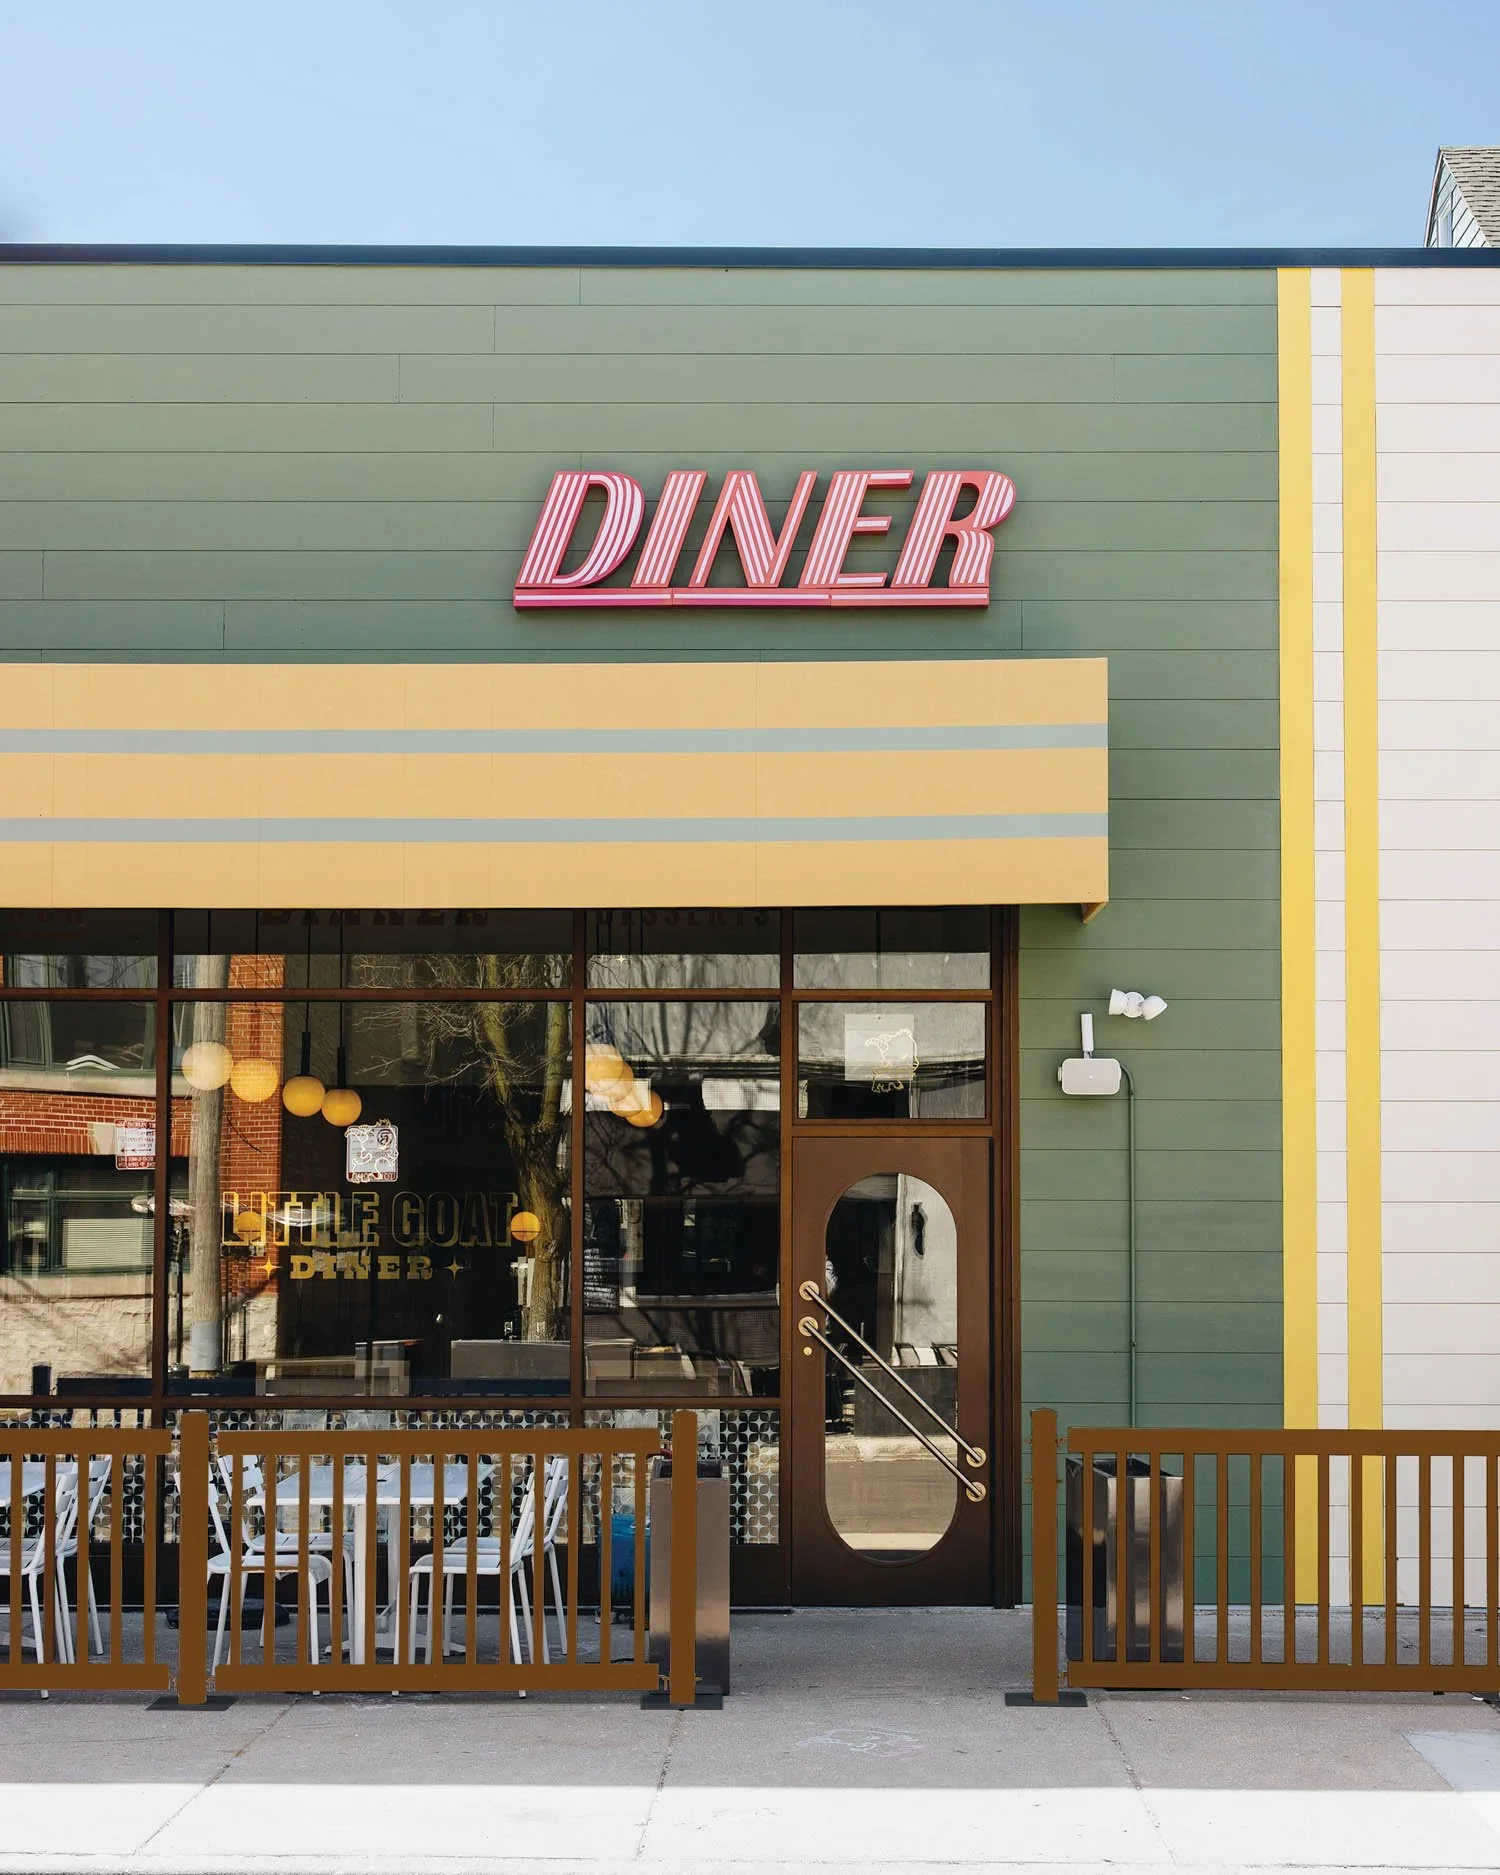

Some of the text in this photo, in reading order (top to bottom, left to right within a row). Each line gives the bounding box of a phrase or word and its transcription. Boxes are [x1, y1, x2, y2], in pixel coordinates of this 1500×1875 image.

[514, 470, 1017, 588] DINER
[222, 1191, 519, 1247] LITTLE GOAT
[290, 1255, 434, 1280] DINER
